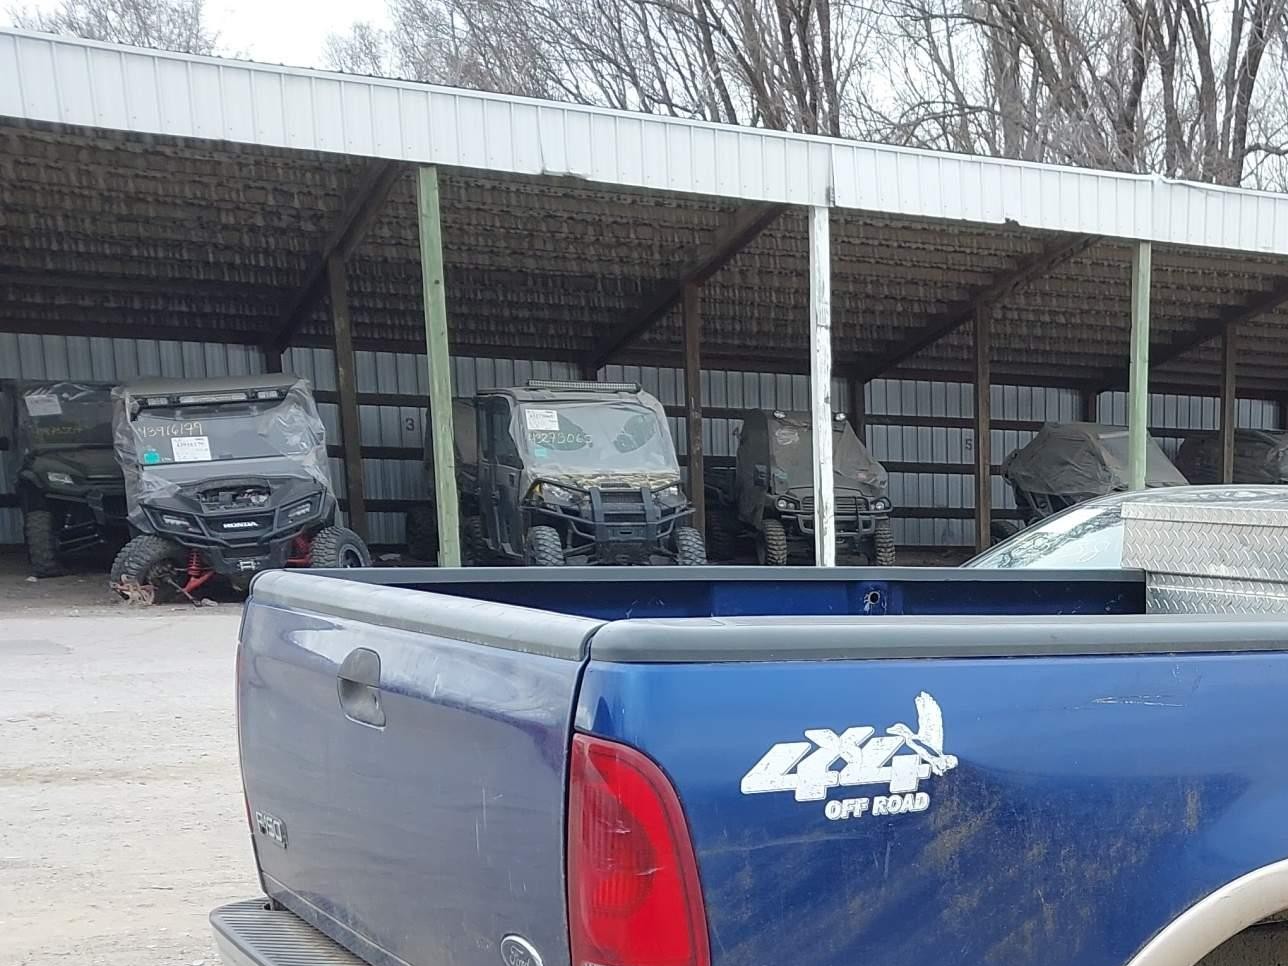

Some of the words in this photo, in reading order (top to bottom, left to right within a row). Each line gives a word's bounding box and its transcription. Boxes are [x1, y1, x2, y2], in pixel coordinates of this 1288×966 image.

[405, 417, 415, 432] 3
[964, 438, 973, 451] 5
[223, 521, 259, 529] HONDA
[824, 797, 870, 821] OFF
[871, 792, 931, 817] ROAD
